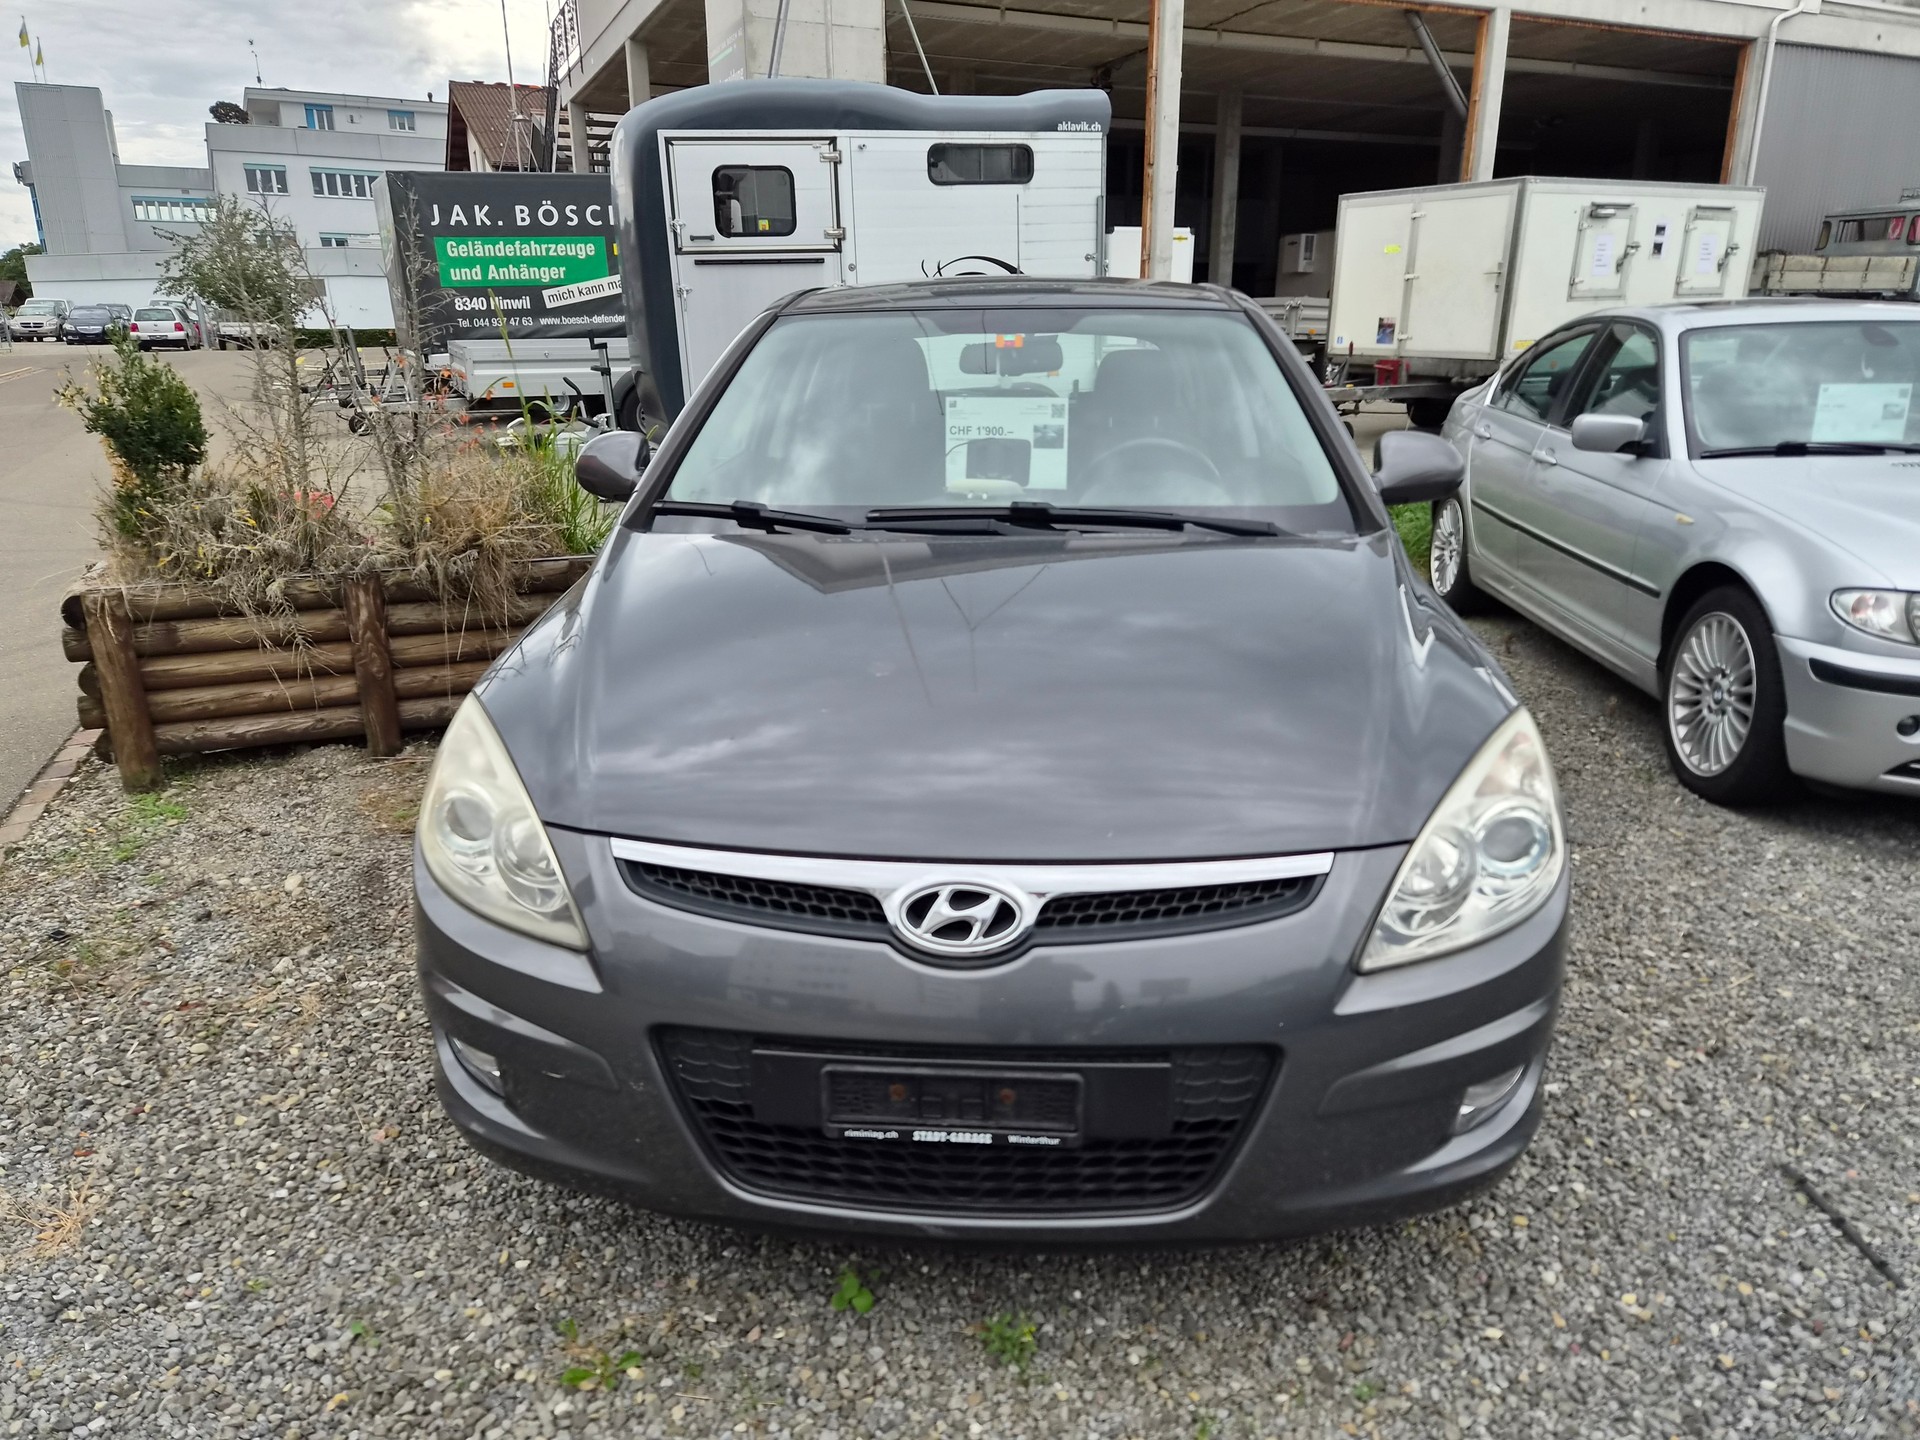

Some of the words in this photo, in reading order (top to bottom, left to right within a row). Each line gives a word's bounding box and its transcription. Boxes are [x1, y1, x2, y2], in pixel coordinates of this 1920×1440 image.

[1057, 121, 1101, 131] aklavik.ch
[430, 203, 503, 227] JAK.
[446, 239, 595, 259] Geländefahrzeuge
[450, 265, 482, 282] und
[487, 263, 566, 283] Anhänger
[547, 287, 576, 304] mich
[577, 283, 606, 298] kann
[454, 297, 487, 311] 8340
[490, 295, 531, 310] Hinwil
[457, 318, 472, 328] Tel.
[473, 317, 490, 328] 044
[509, 317, 520, 327] 47
[521, 316, 533, 326] 63
[949, 425, 972, 436] CHF
[1007, 1134, 1062, 1146] Winterthur
